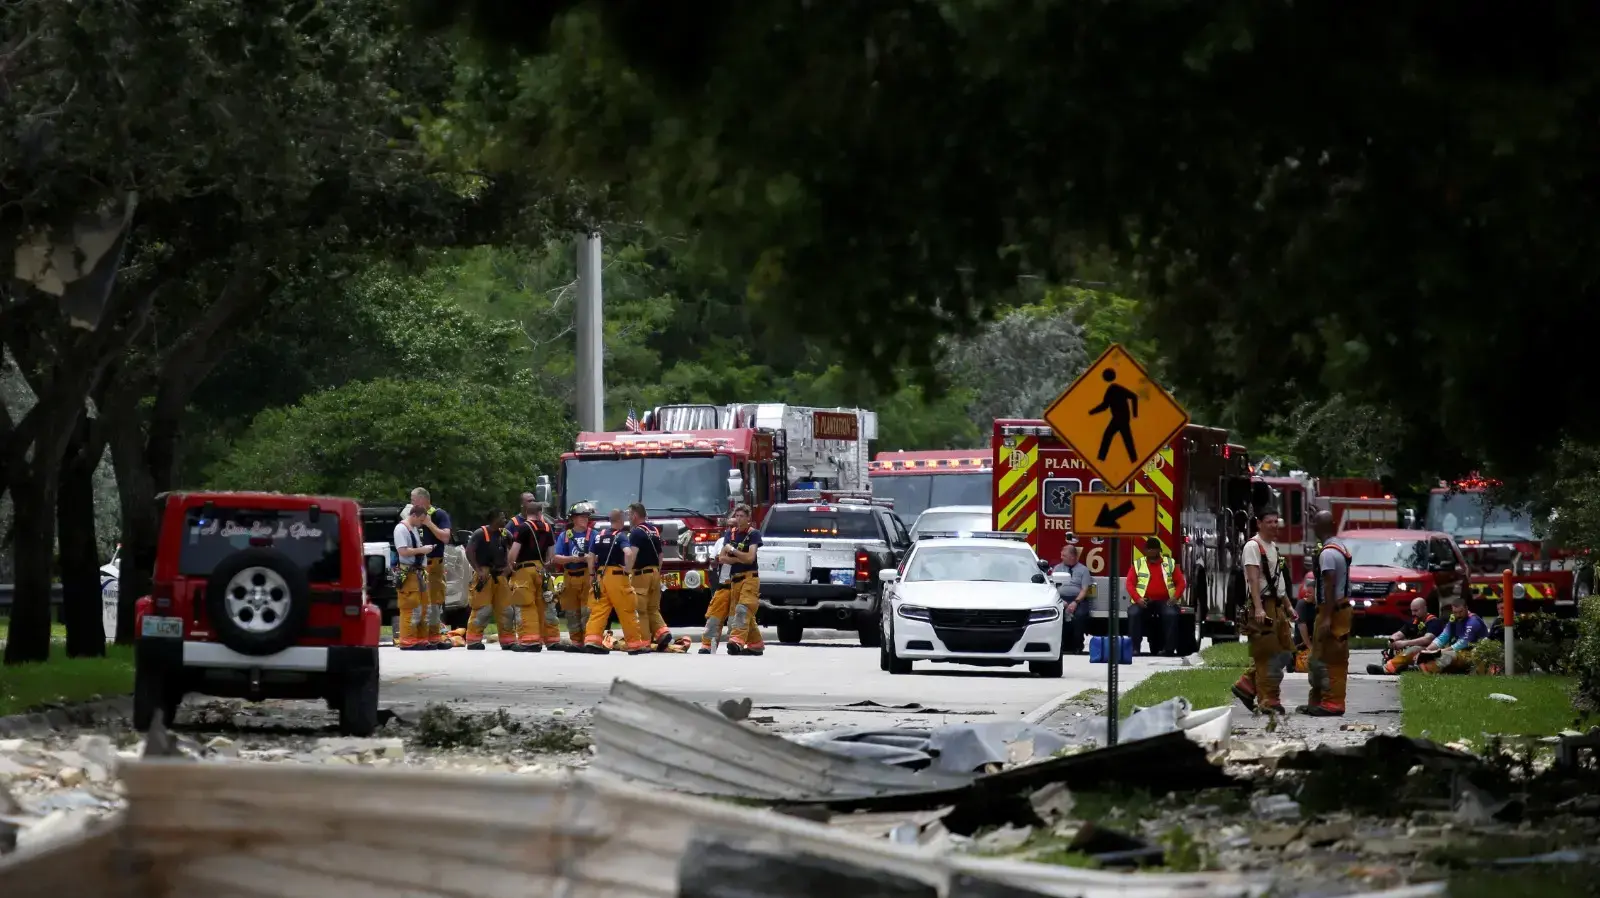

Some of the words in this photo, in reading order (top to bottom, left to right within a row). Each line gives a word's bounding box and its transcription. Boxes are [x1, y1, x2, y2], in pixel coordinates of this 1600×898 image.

[821, 415, 851, 436] PLANTATION
[1045, 458, 1090, 469] PLANT
[1044, 519, 1071, 530] FIRE
